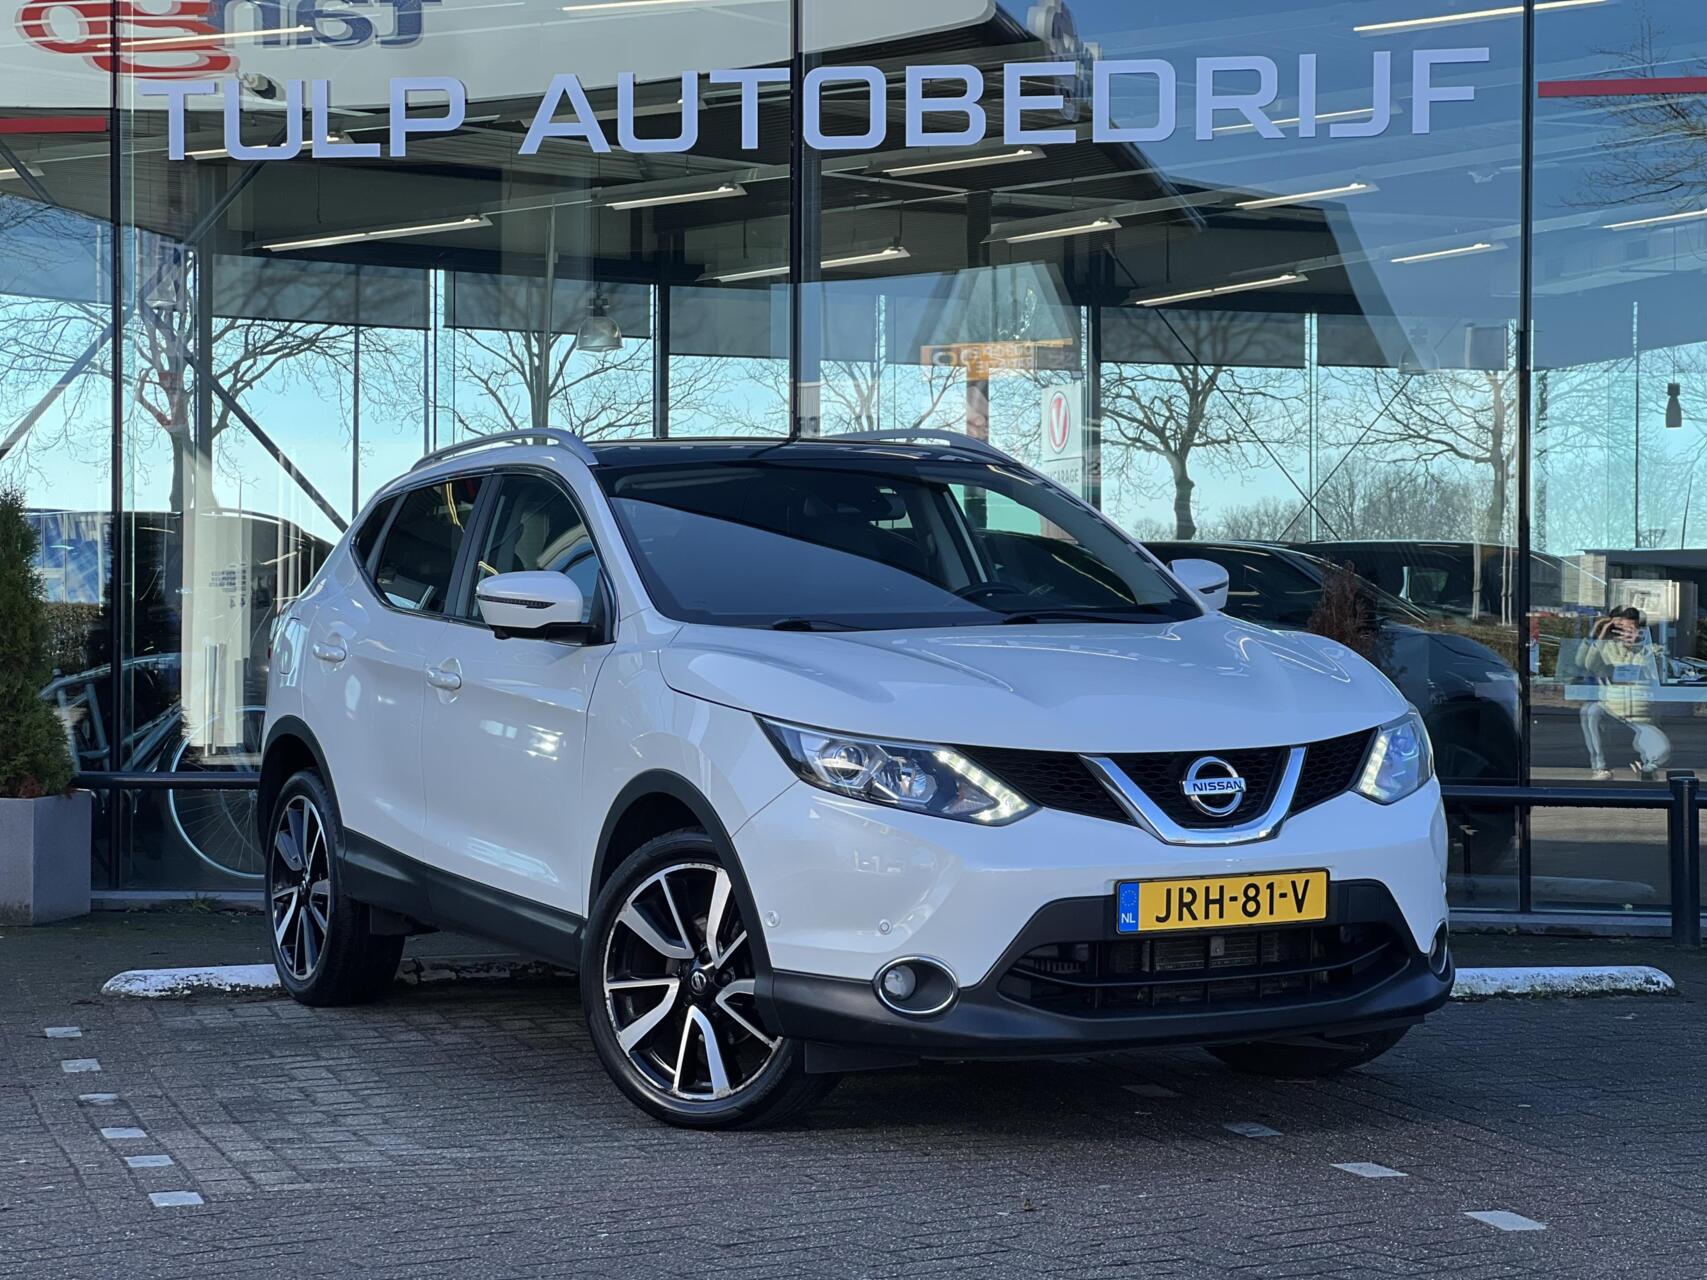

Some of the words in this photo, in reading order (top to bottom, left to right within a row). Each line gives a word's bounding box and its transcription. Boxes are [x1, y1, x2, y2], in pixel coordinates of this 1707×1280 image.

[138, 76, 467, 161] TULP
[517, 46, 1490, 155] AUTOBEDRIJF
[1192, 780, 1242, 792] NISSAN
[1121, 912, 1136, 924] NL
[1155, 879, 1310, 923] JRH-81-V
